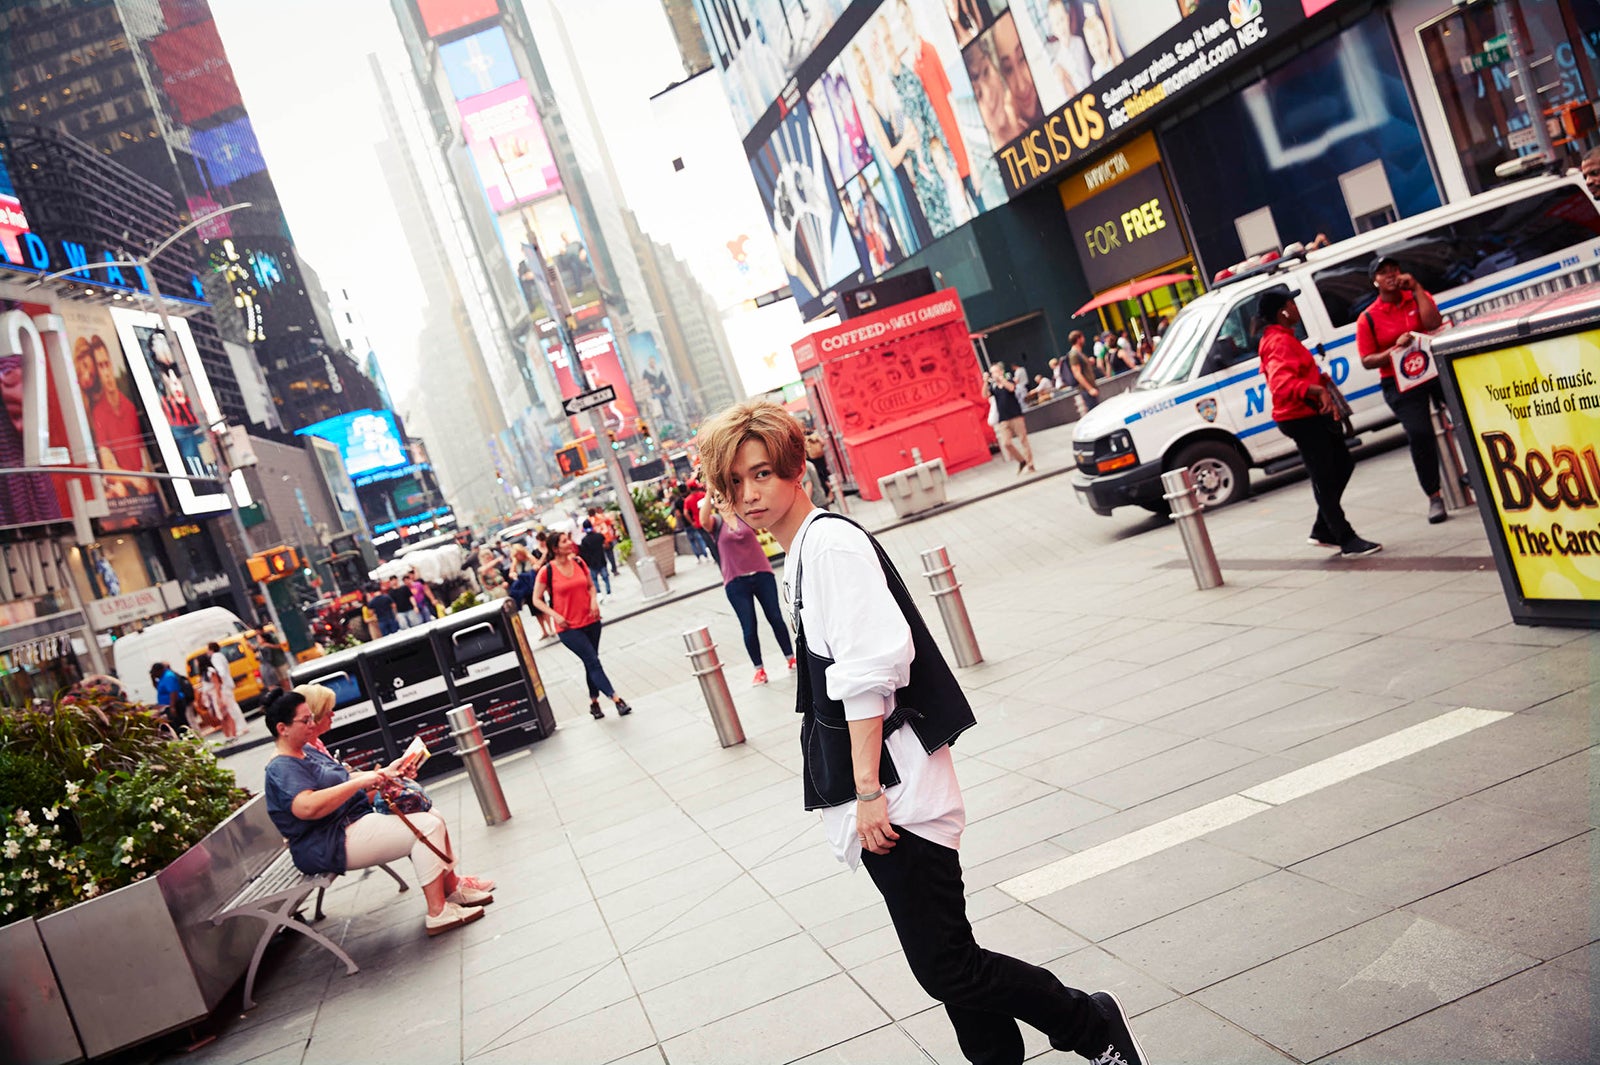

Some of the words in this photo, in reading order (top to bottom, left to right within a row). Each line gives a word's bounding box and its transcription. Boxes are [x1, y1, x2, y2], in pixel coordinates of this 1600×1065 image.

[1236, 16, 1268, 49] NBC
[1130, 68, 1150, 94] your
[1175, 38, 1196, 61] See
[1193, 29, 1205, 49] it
[1000, 129, 1051, 190] THIS
[1044, 115, 1072, 165] IS
[1063, 93, 1105, 149] US
[1085, 220, 1121, 259] FOR
[1121, 198, 1167, 243] FREE
[821, 322, 886, 352] COFFEED
[1485, 384, 1511, 401] Your
[1512, 376, 1539, 398] kind
[1541, 374, 1554, 393] of
[1556, 368, 1597, 391] music.
[1141, 399, 1176, 419] POLICE
[1505, 403, 1532, 420] Your
[1533, 396, 1561, 417] kind
[1563, 393, 1577, 413] of
[1579, 394, 1600, 411] mu
[1508, 523, 1552, 557] The
[1551, 522, 1600, 557] Caro
